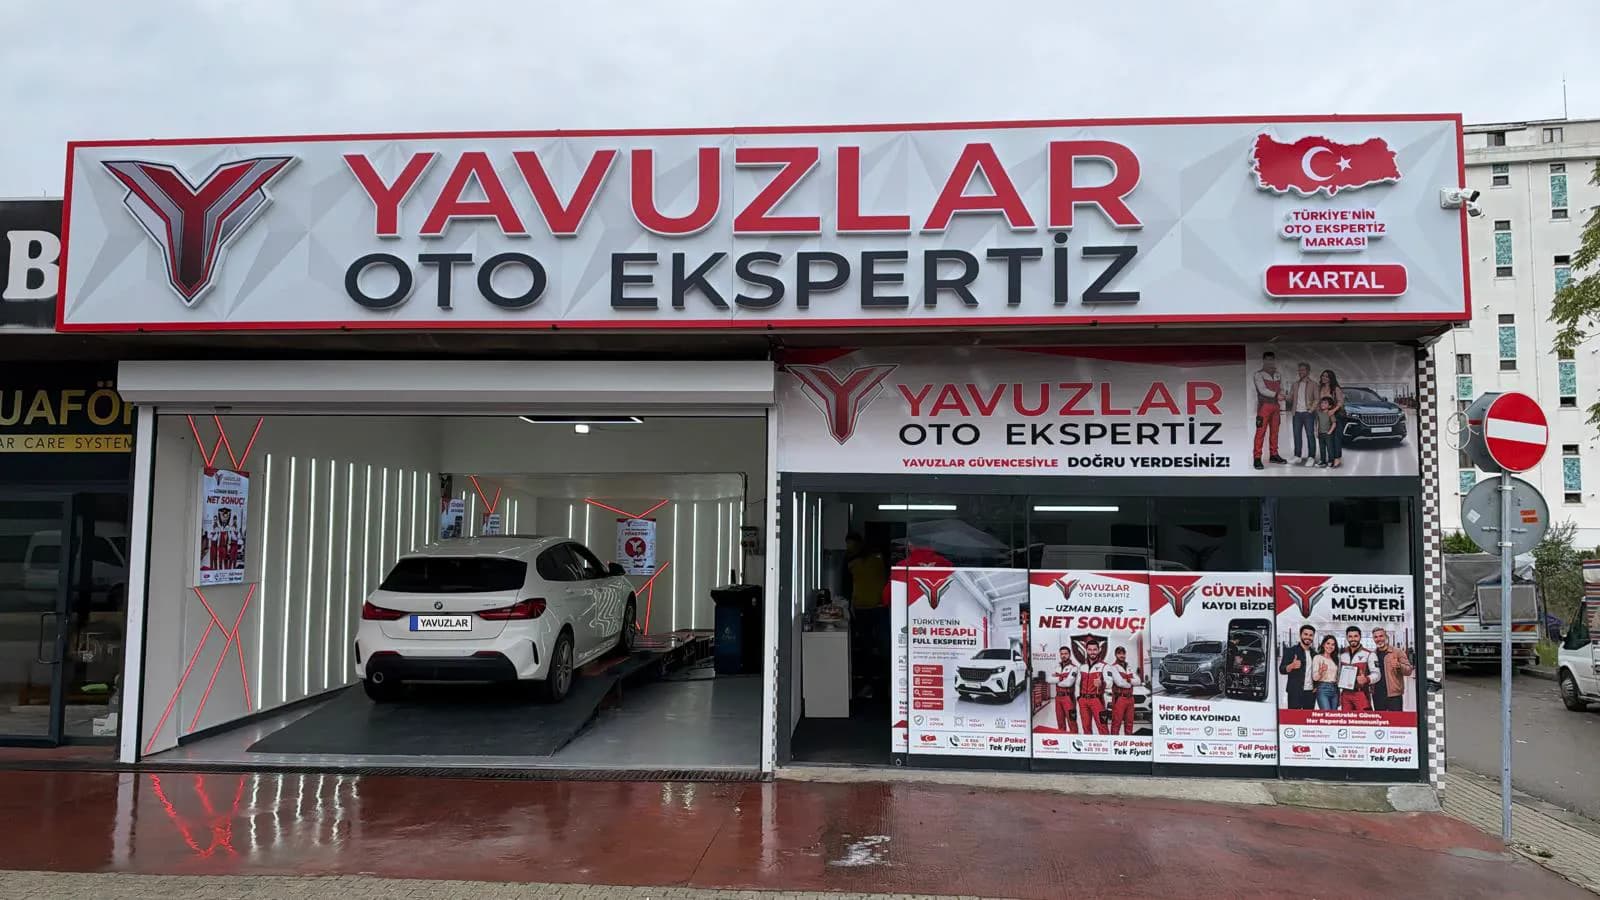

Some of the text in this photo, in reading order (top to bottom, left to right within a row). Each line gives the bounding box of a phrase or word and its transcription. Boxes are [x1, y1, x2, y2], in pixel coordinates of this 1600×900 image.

[344, 140, 1142, 238] YAVUZLAR
[1293, 209, 1376, 221] TÜRKİYE'NİN
[1285, 221, 1386, 234] OTO EKSPERTİZ
[1305, 237, 1366, 247] MARKASI
[2, 230, 61, 300] B
[345, 230, 1140, 312] OTO EKSPERTİZ
[1289, 271, 1385, 289] KARTAL
[899, 381, 1223, 417] YAVUZLAR
[899, 416, 1223, 446] OTO EKSPERTİZ
[24, 437, 65, 449] CARE
[903, 454, 1231, 469] YAVUZLAR GÜVENCESİYLE DOĞRU YERDESİNİZ!
[206, 495, 220, 504] NET
[1079, 584, 1130, 592] YAVUZLAR
[1201, 582, 1274, 598] GÜVENİN
[1331, 583, 1405, 595] ÖNCELİĞİMİZ
[1202, 599, 1275, 610] KAYDI BİZDE
[1331, 594, 1405, 612] MÜŞTERİ
[1055, 604, 1124, 615] UZMAN BAKIŞ
[420, 618, 468, 627] YAVUZLAR
[912, 617, 961, 626] TÜRKİYE'NİN
[1332, 612, 1405, 623] MEMNUNİYETİ
[1038, 615, 1147, 633] NET SONUÇ!
[930, 627, 977, 637] HESAPLI
[912, 637, 977, 646] FULL EKSPERTİZİ
[1177, 704, 1211, 712] Kontrol
[1159, 712, 1241, 722] VİDEO KAYDINDA!
